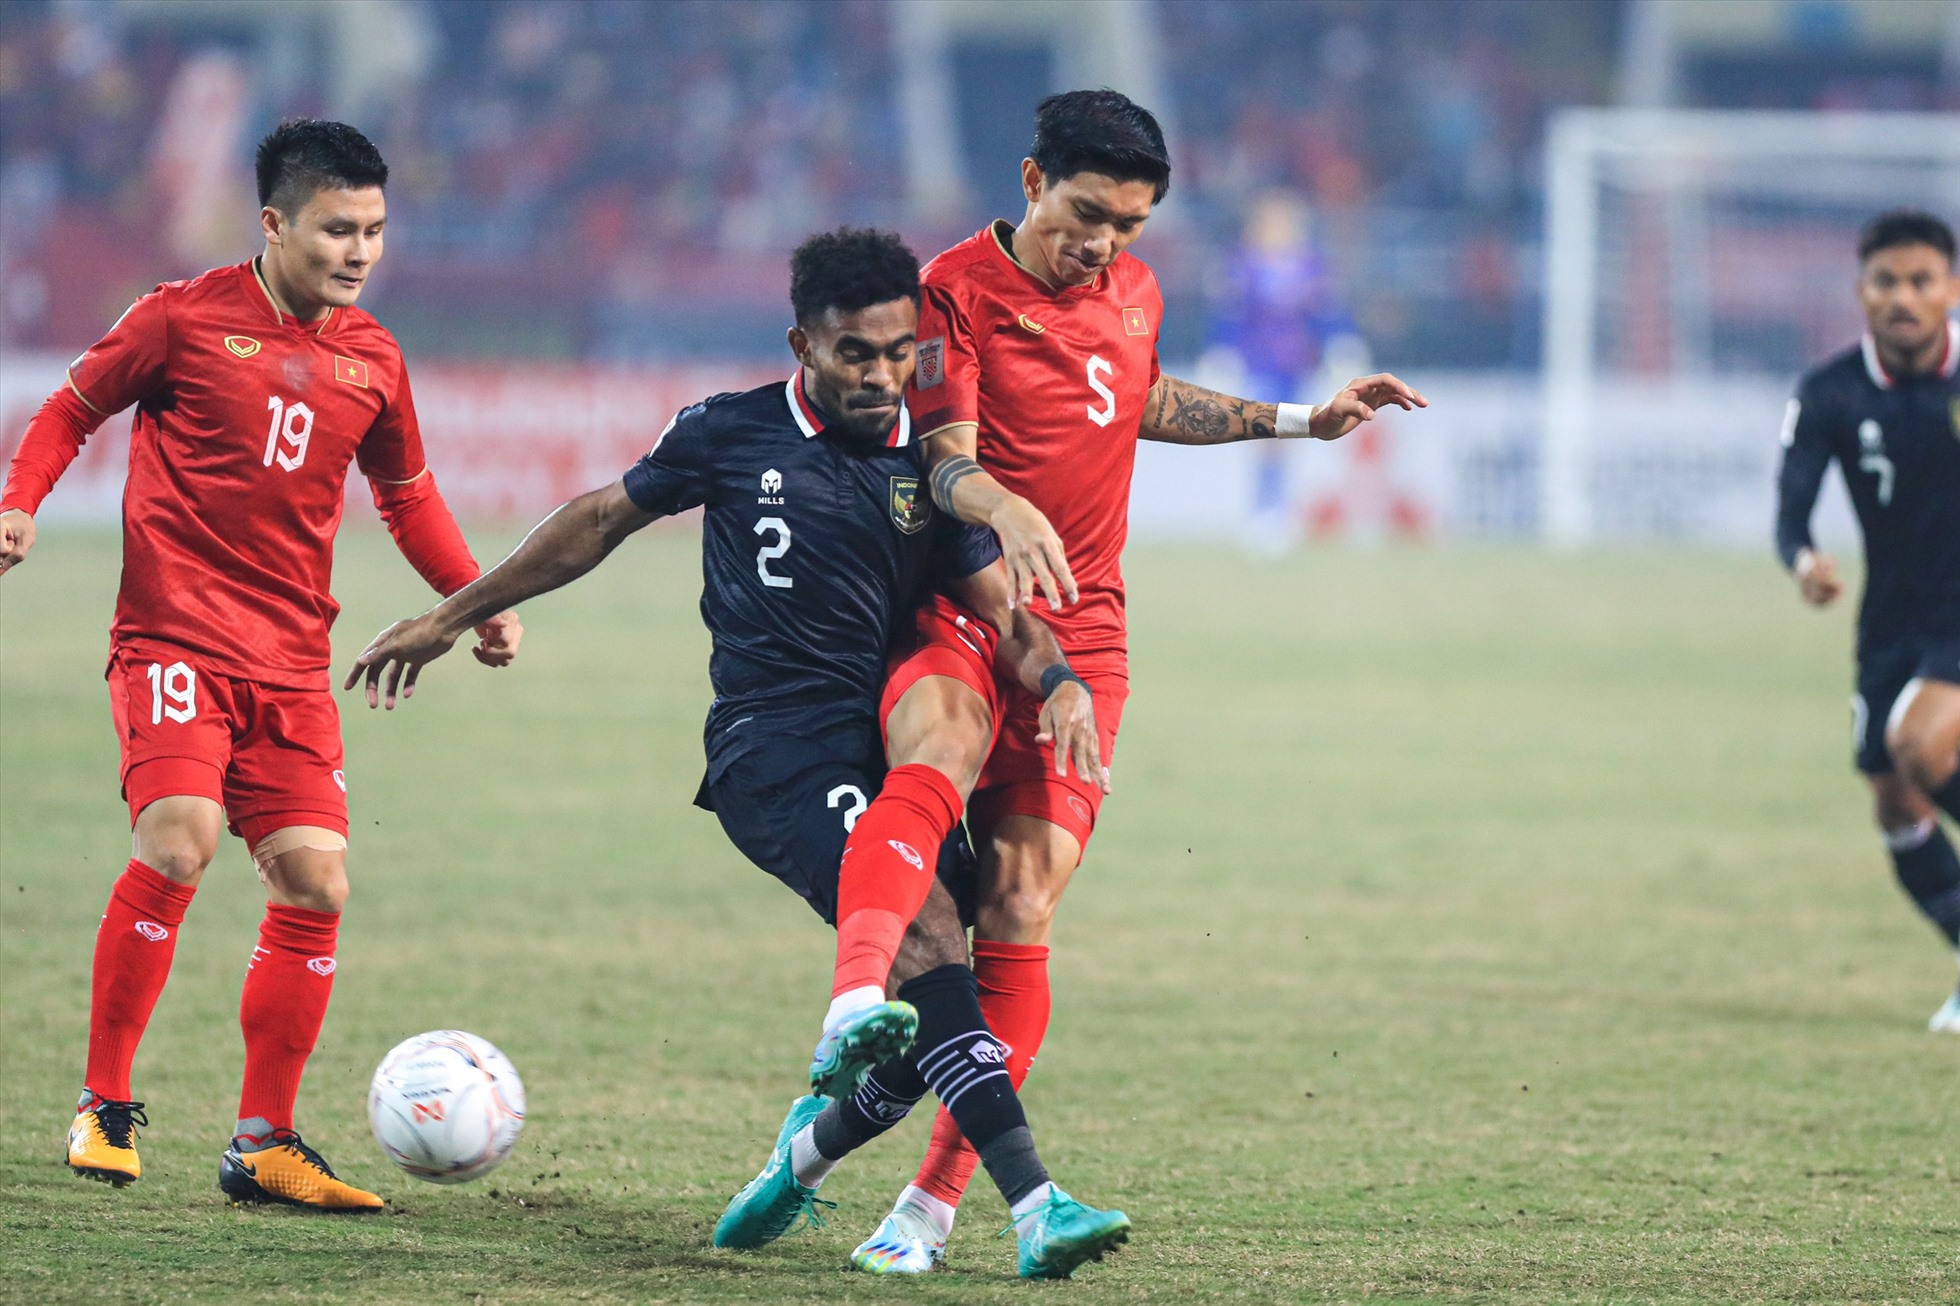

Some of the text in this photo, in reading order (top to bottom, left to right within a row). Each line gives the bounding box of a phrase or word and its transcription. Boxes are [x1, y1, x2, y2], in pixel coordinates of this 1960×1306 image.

[262, 395, 315, 473] 19
[757, 497, 785, 505] MILLS
[1859, 454, 1895, 507] 7
[752, 516, 793, 588] 2
[146, 660, 197, 725] 19
